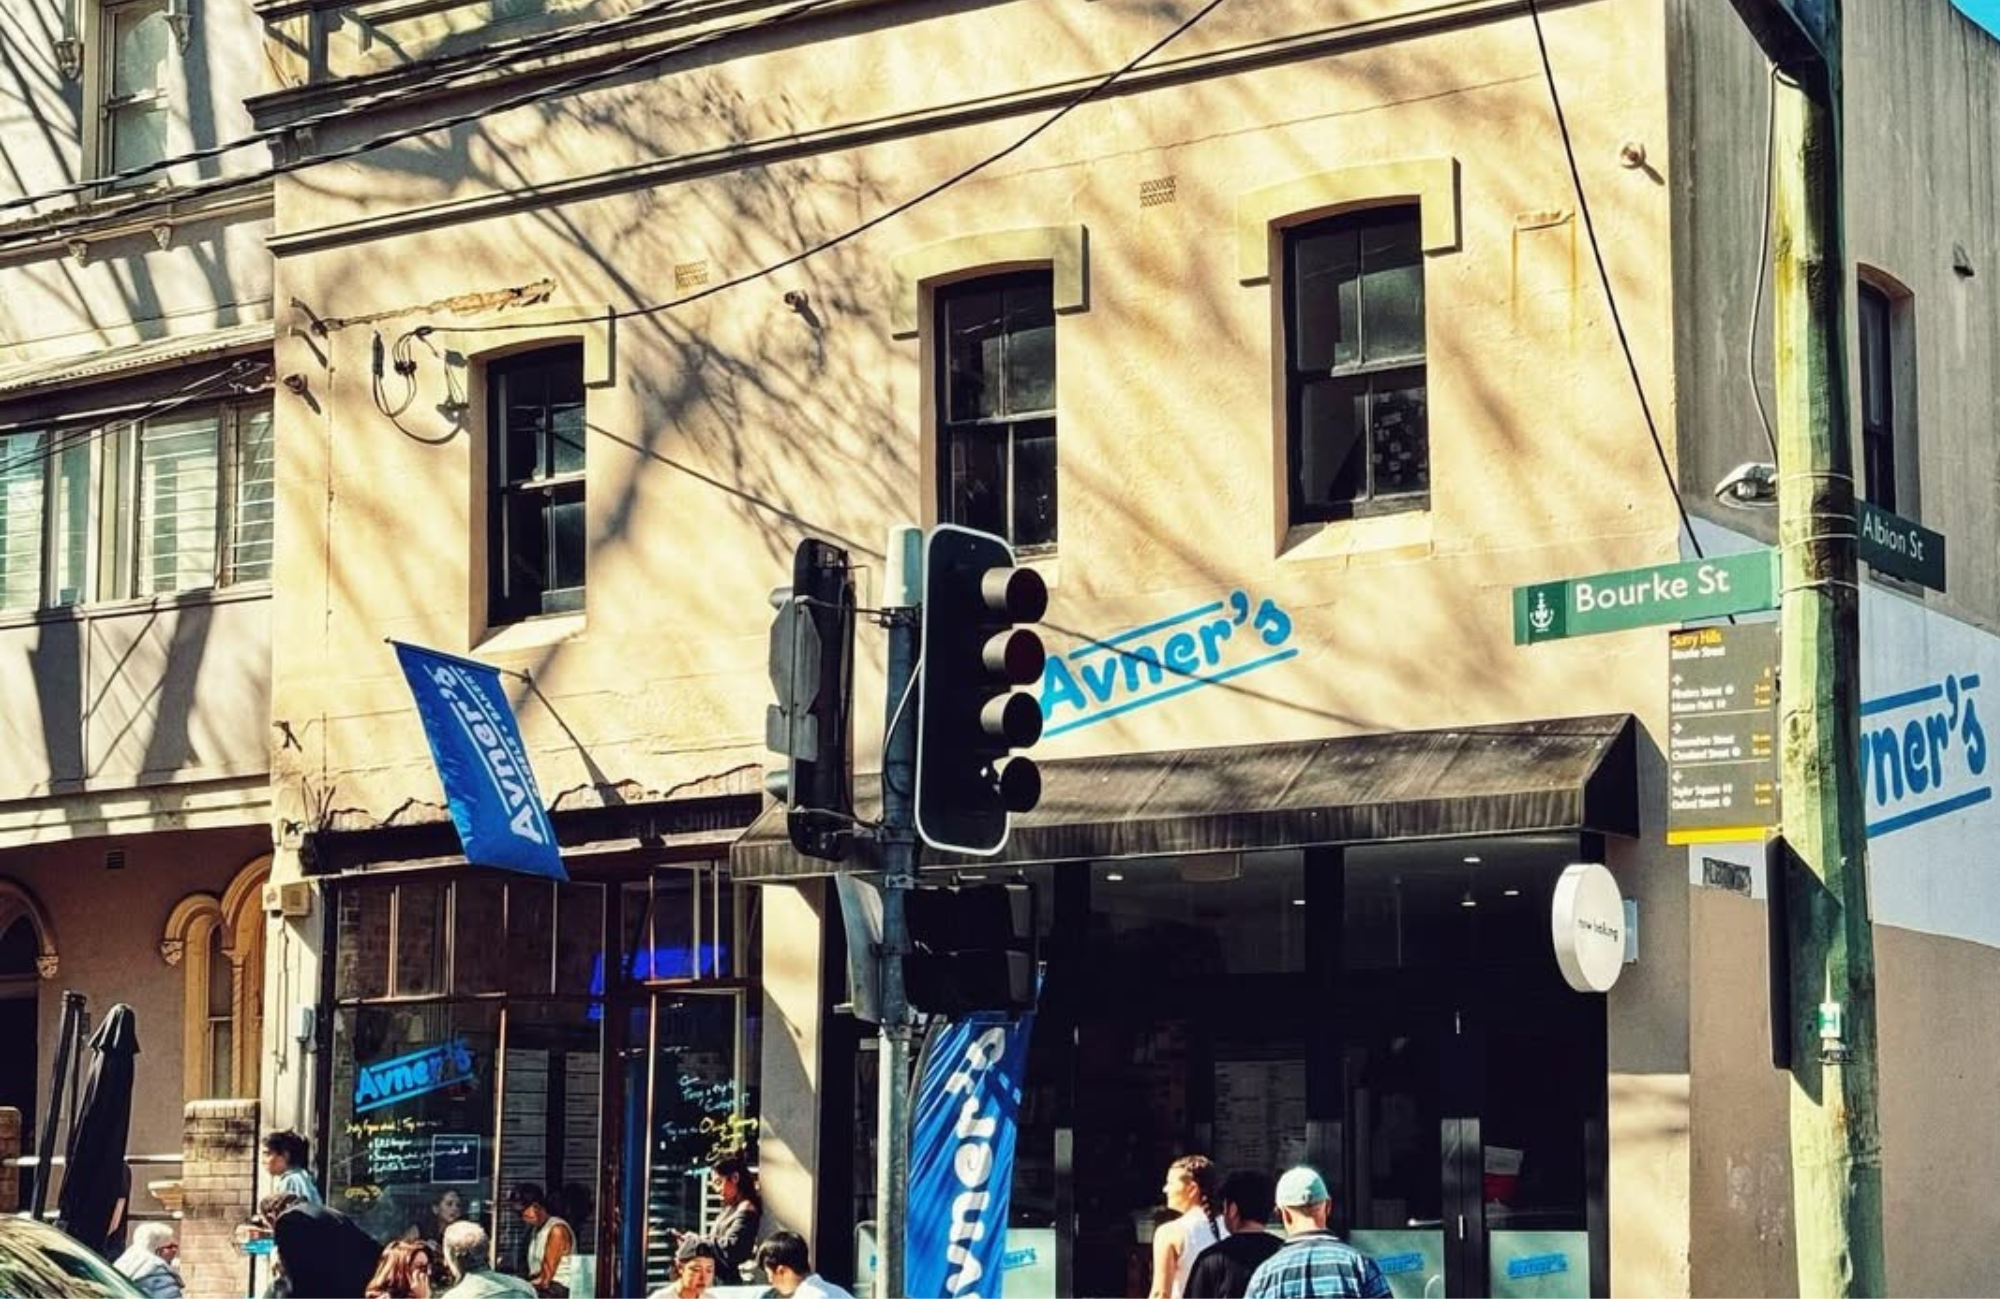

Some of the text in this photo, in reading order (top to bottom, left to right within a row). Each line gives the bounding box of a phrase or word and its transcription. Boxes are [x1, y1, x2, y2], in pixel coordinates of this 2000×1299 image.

[1575, 565, 1731, 613] Bourke St
[1862, 511, 1924, 562] Albion St
[1040, 590, 1292, 720] Avner's
[433, 666, 544, 845] Avner's
[945, 1026, 1006, 1299] vner's
